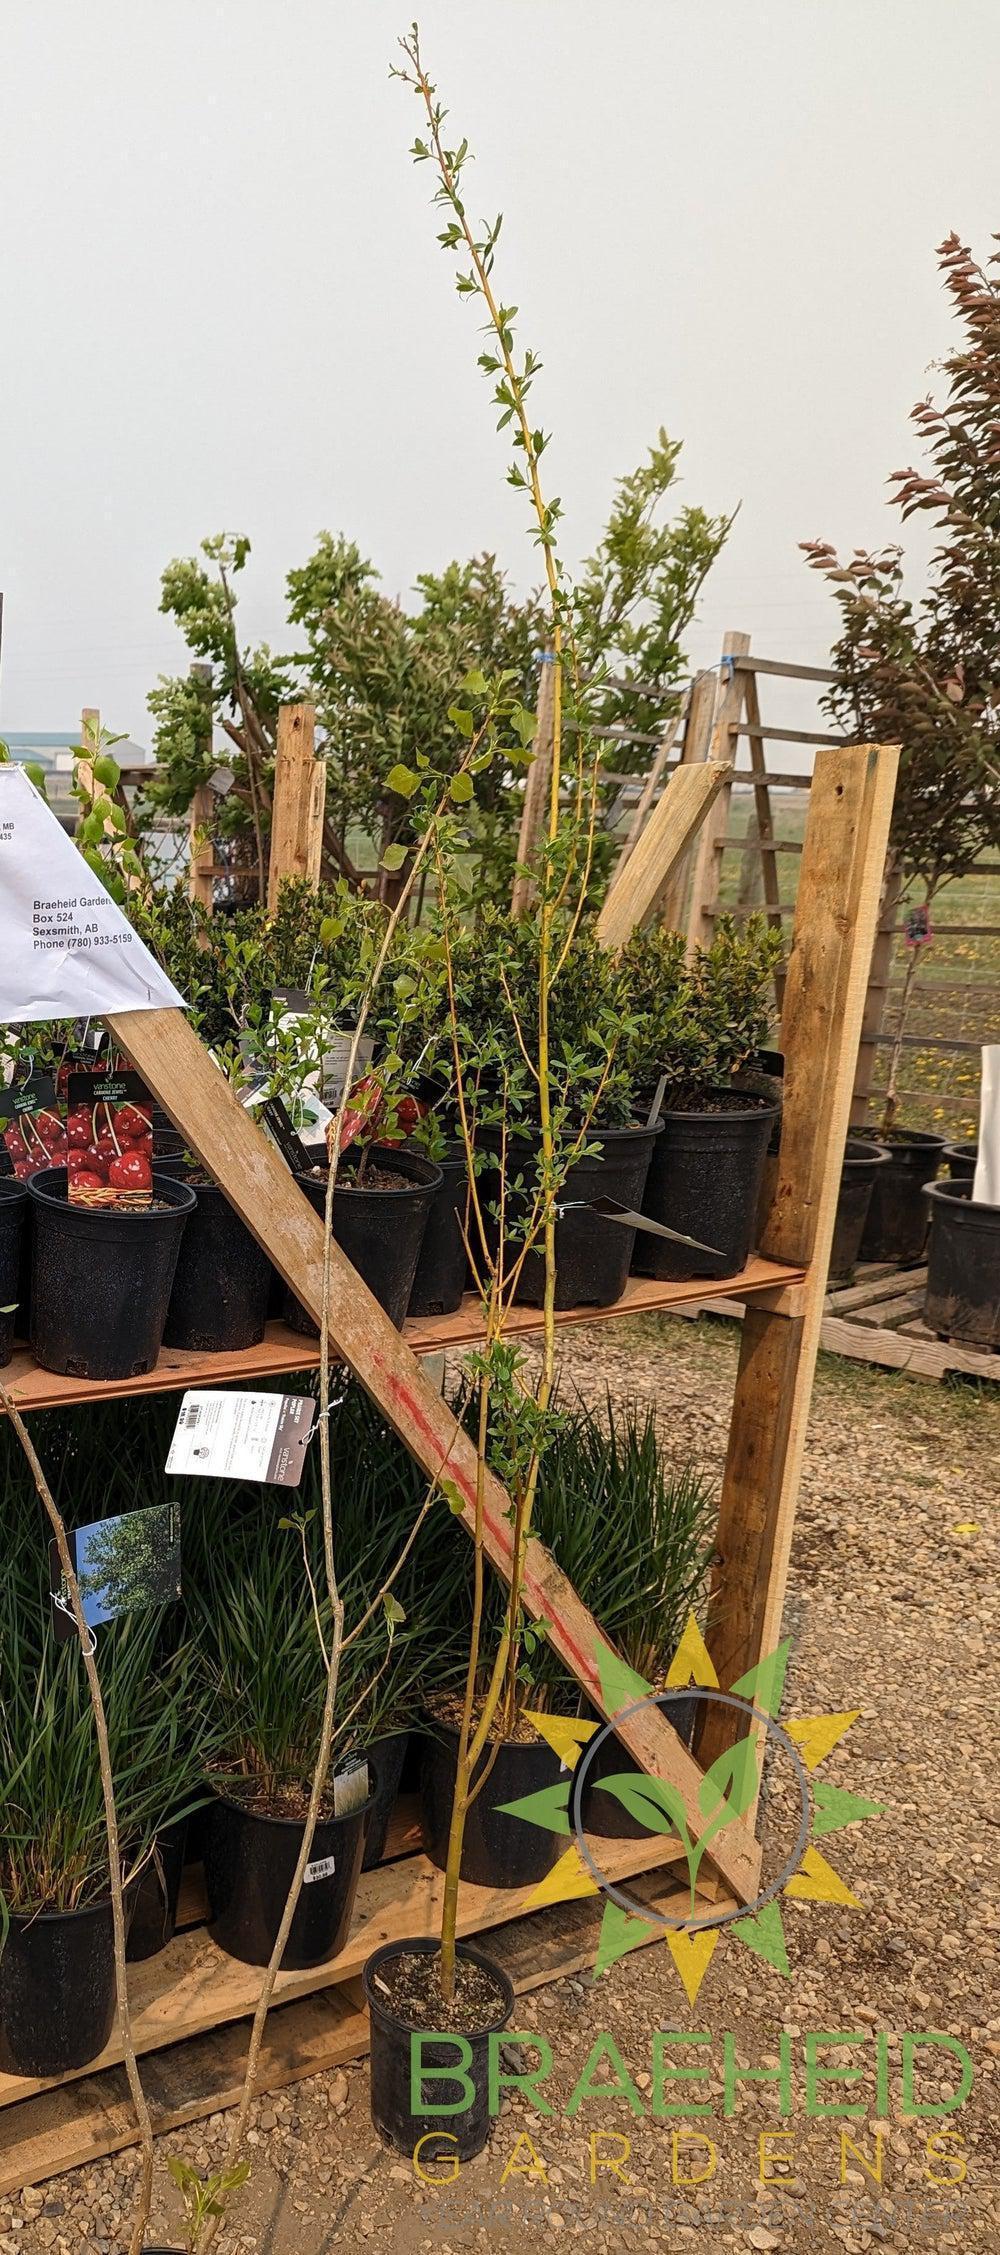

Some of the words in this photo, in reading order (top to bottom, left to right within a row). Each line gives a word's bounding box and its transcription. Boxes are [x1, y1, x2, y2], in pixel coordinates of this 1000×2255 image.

[2, 822, 15, 830] MB
[33, 898, 77, 910] Braeheid
[79, 896, 112, 907] Garden
[33, 914, 53, 923] Box
[56, 912, 73, 922] 524
[33, 925, 82, 936] Sexsmith,
[84, 923, 99, 934] AB
[33, 939, 65, 950] Phone
[67, 937, 92, 949] (780)
[93, 933, 133, 946] 933-5159
[276, 1447, 291, 1481] vanstone
